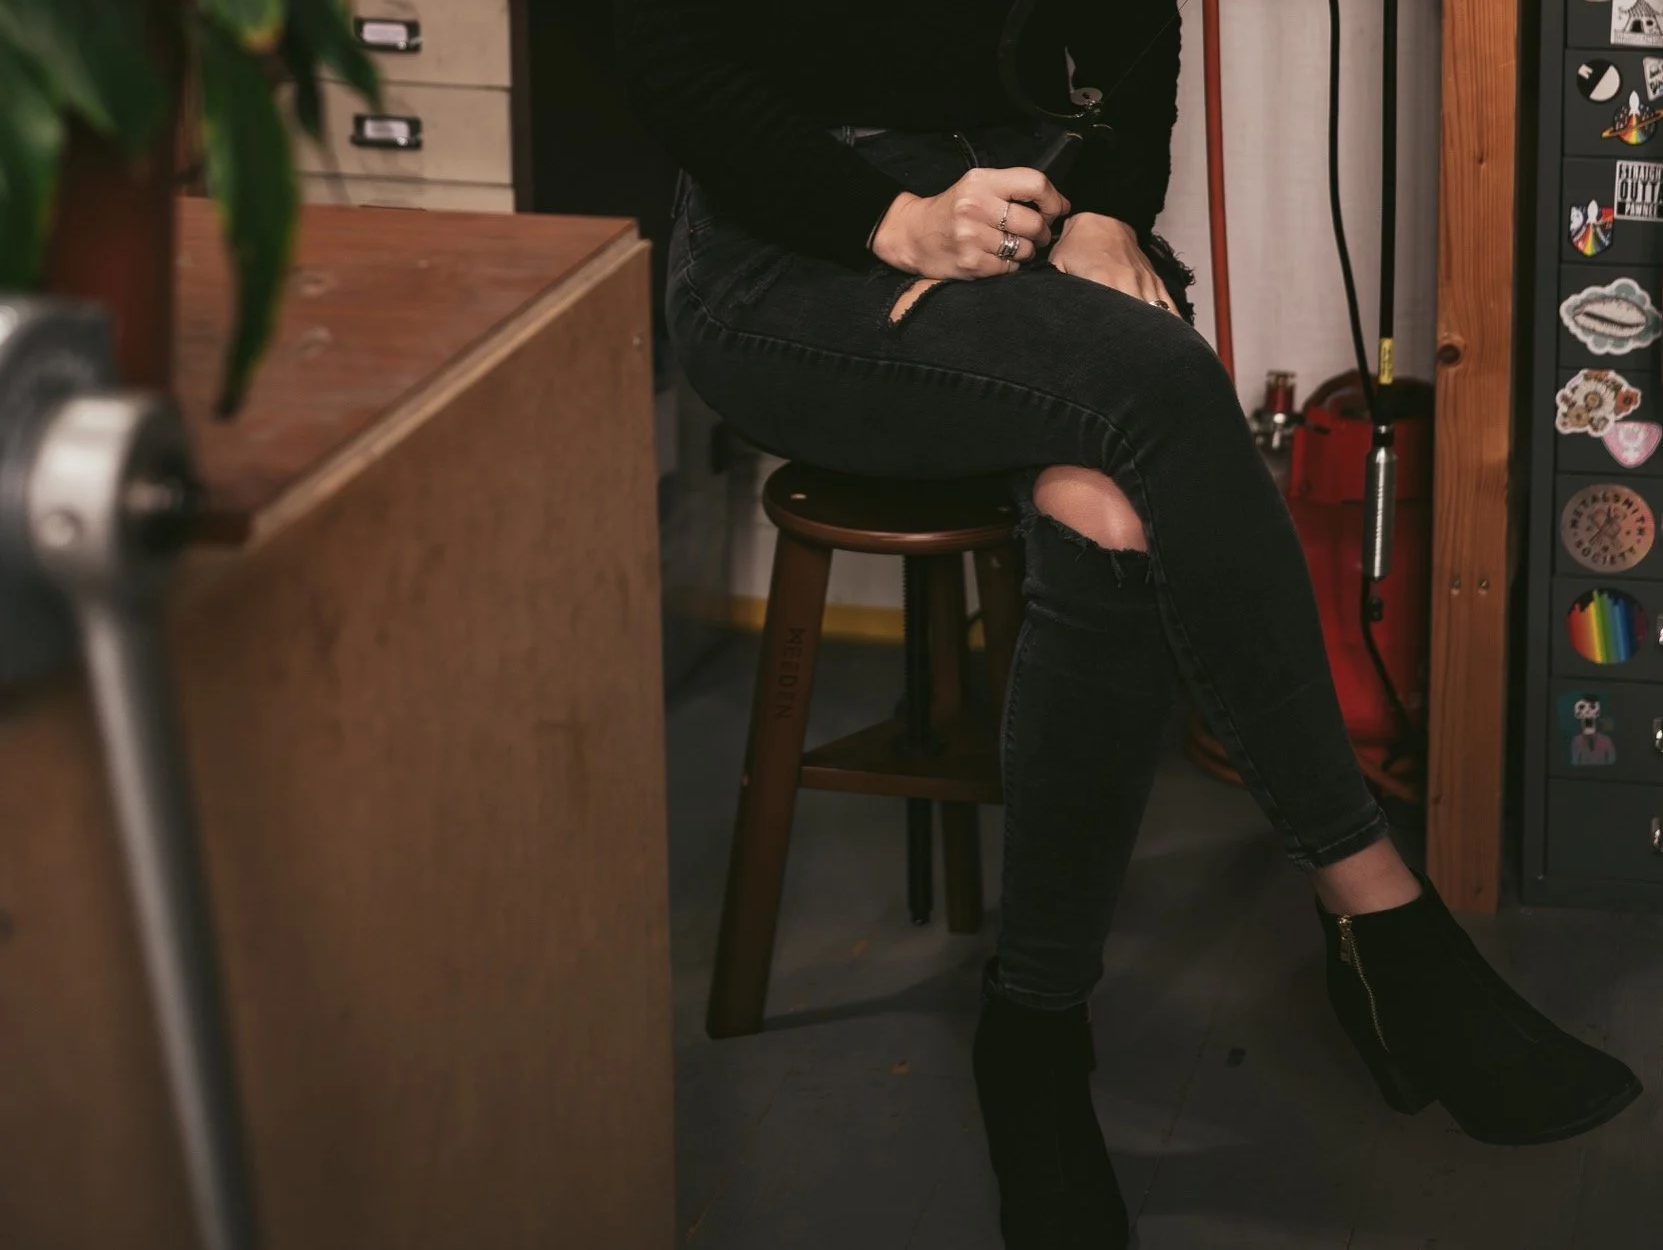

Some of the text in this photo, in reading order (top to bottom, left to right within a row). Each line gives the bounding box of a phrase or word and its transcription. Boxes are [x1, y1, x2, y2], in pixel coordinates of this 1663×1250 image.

[1619, 163, 1663, 181] STRAIGH
[1570, 491, 1646, 536] METALSMITH
[1574, 539, 1636, 566] SOCIETY
